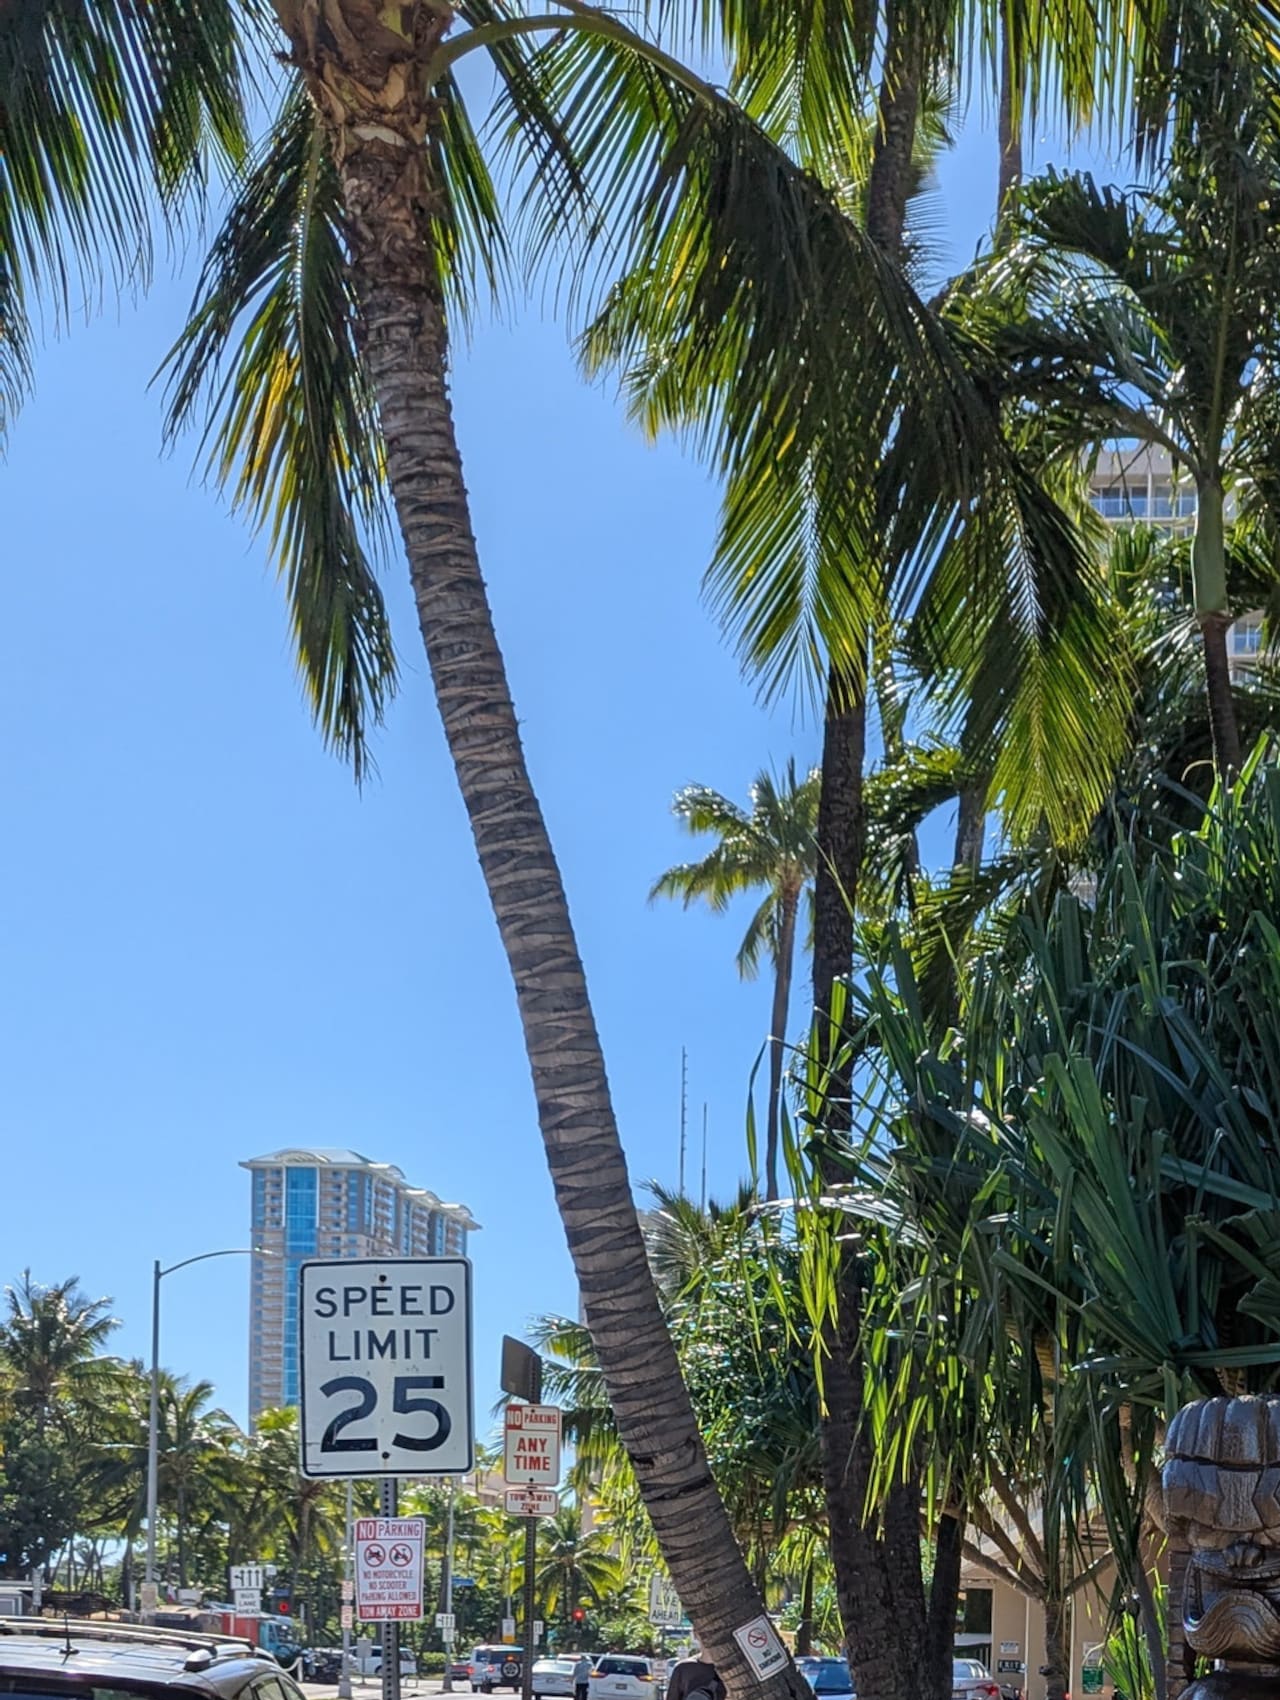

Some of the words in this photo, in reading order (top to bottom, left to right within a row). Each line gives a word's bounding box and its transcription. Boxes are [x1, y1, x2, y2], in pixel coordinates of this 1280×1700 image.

[314, 1285, 455, 1318] SPEED
[329, 1329, 438, 1361] LIMIT
[319, 1375, 452, 1453] 25
[507, 1410, 522, 1426] NO
[524, 1413, 557, 1425] PARKING
[516, 1437, 548, 1453] ANY
[513, 1455, 551, 1471] TIME
[520, 1502, 541, 1511] ZONE
[358, 1522, 375, 1539] NO
[378, 1523, 421, 1537] PARKING
[363, 1570, 372, 1579] NO
[373, 1570, 414, 1579] MOTORCYCLE
[368, 1581, 378, 1590] NO
[378, 1581, 407, 1590] SCOOTER
[361, 1592, 386, 1601] PARKING
[388, 1591, 417, 1601] ALLOWED
[361, 1606, 375, 1617] TOW
[376, 1606, 396, 1617] AWAY
[398, 1605, 419, 1616] ZONE
[758, 1652, 782, 1670] SMOKING
[762, 1649, 772, 1658] NO
